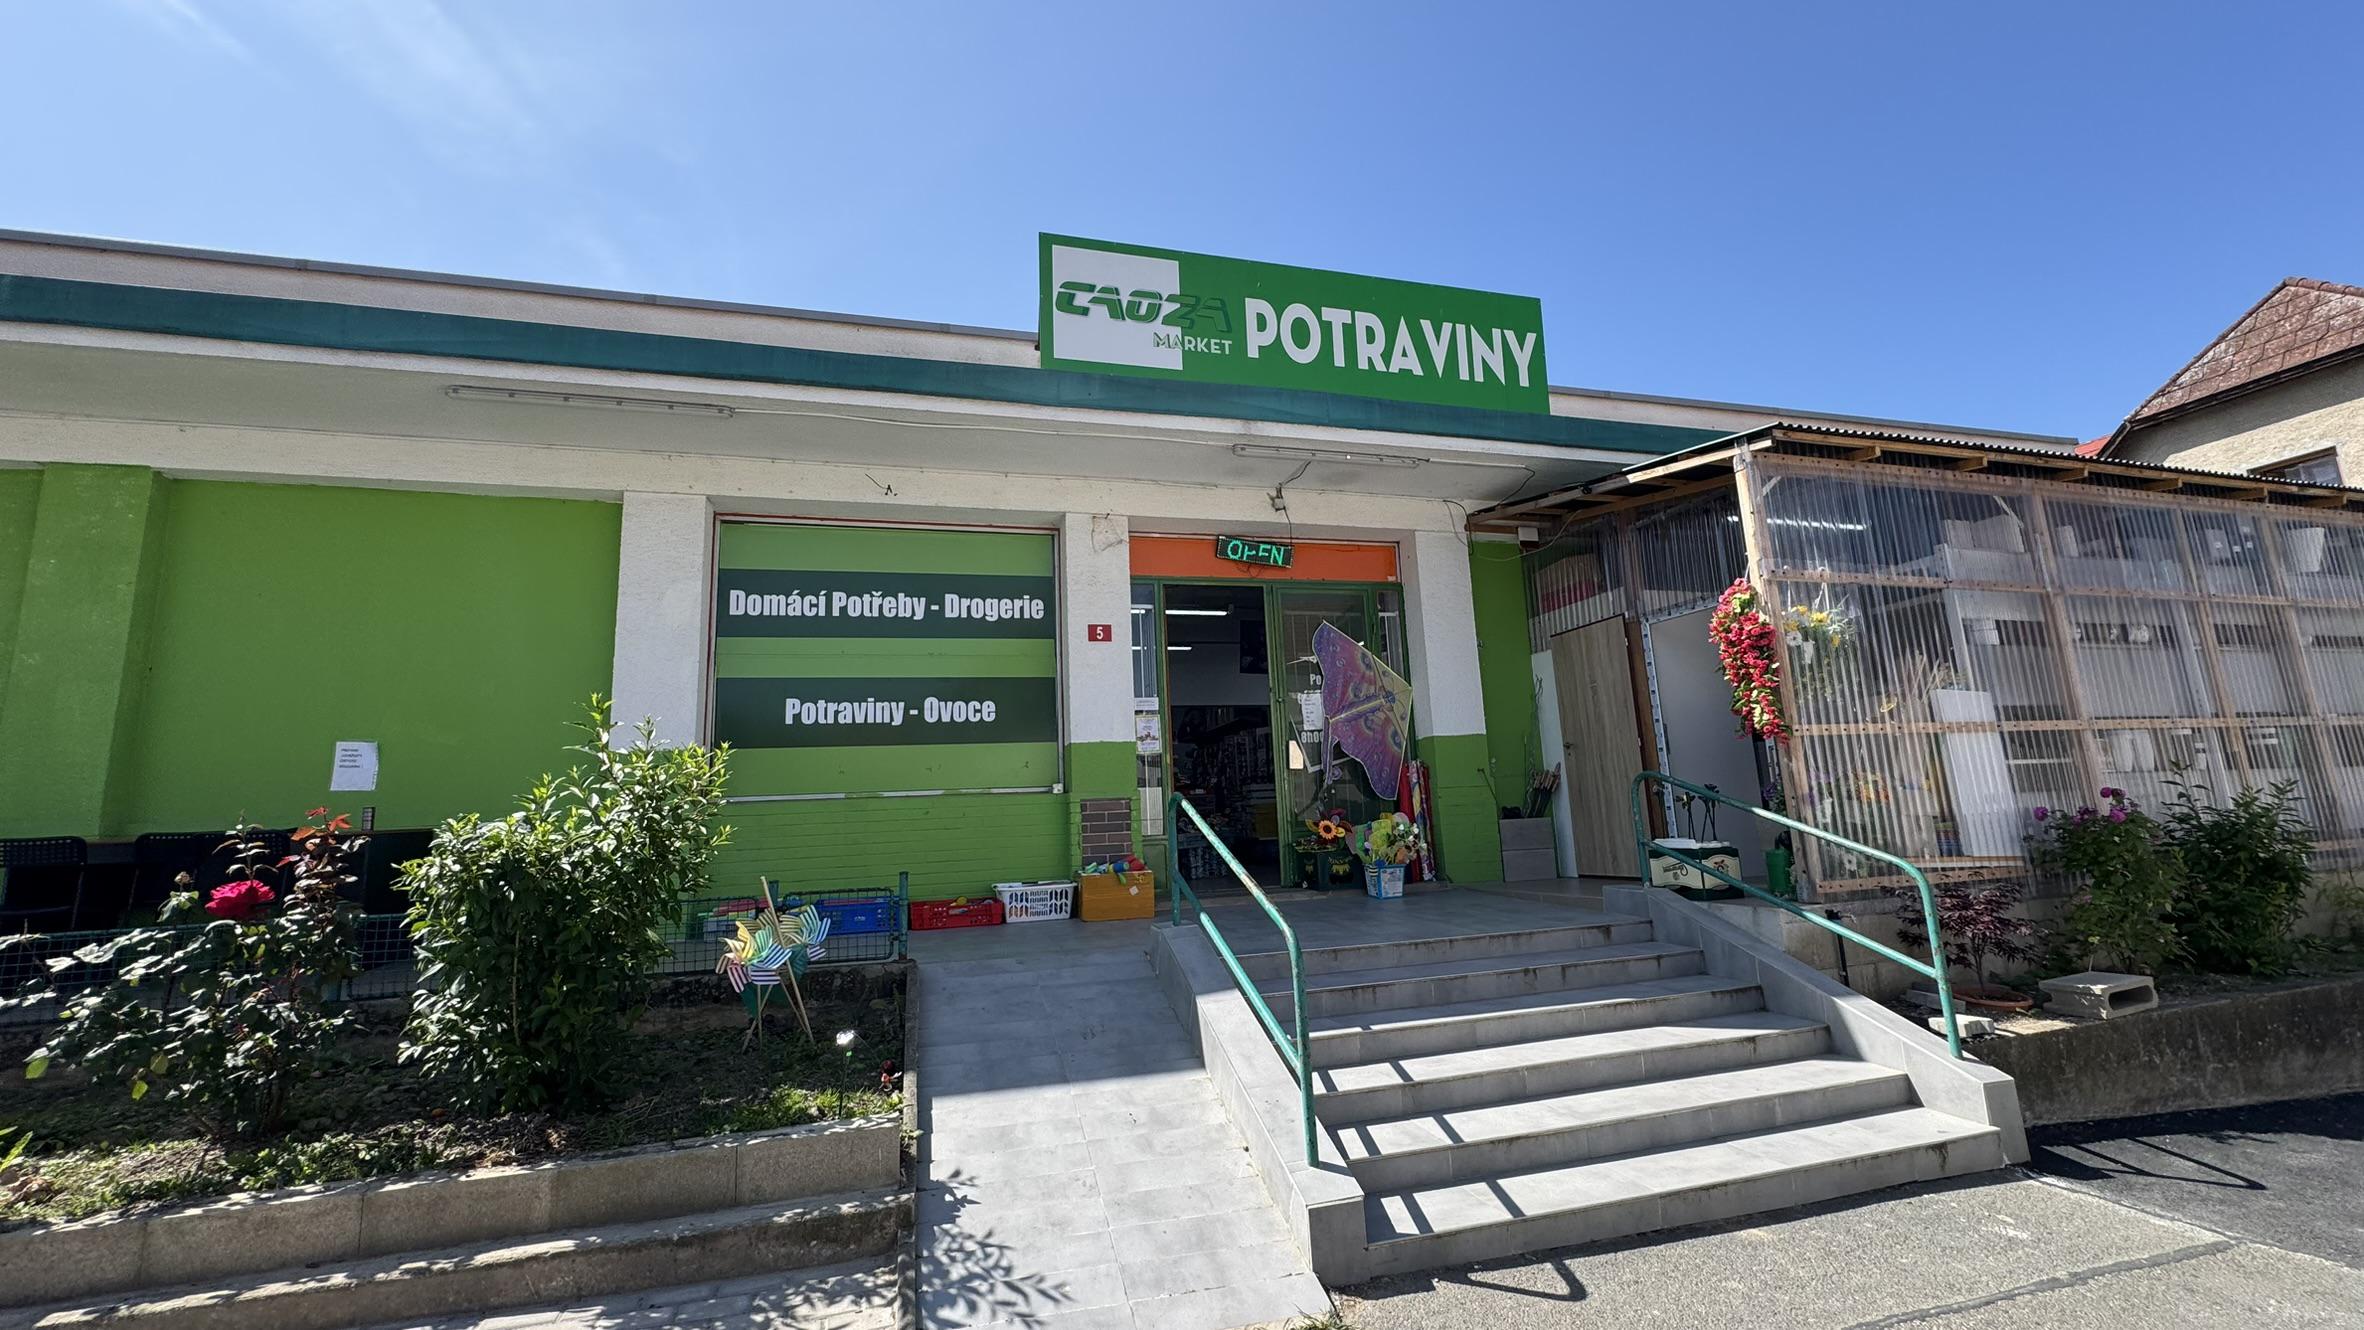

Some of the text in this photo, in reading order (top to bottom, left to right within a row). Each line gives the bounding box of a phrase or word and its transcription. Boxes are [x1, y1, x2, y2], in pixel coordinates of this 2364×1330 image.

[1055, 281, 1232, 334] CAOZA
[1152, 332, 1233, 356] MARKET
[1245, 297, 1537, 388] POTRAVINY
[729, 589, 827, 616] Domácí
[832, 590, 926, 621] Potřeby
[944, 593, 1045, 622] Drogerie
[1096, 626, 1104, 640] 5
[785, 698, 905, 726] Potraviny
[924, 696, 996, 723] Ovoce
